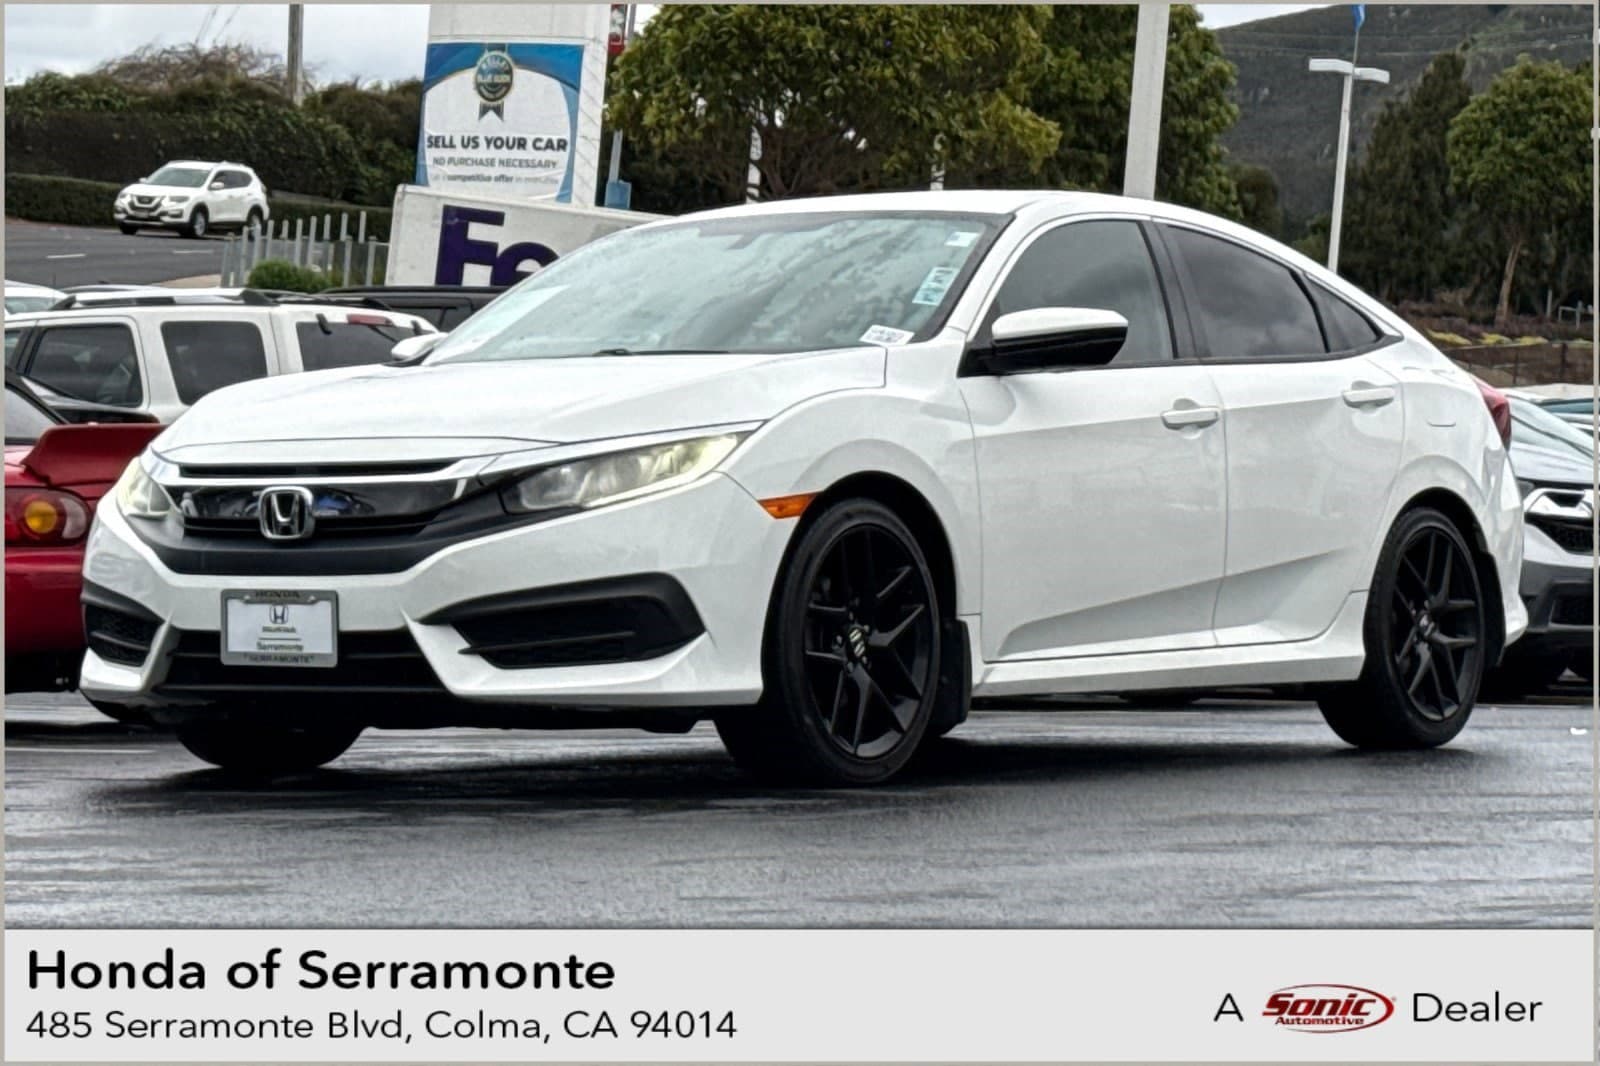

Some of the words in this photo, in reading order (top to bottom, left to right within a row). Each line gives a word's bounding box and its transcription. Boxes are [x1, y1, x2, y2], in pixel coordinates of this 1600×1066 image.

[427, 135, 456, 149] SELL
[461, 136, 480, 149] US
[484, 136, 527, 150] YOUR
[532, 137, 568, 152] CAR
[433, 157, 445, 166] NO
[447, 157, 496, 168] PURCHASE
[500, 158, 558, 169] NECESSARY
[447, 174, 492, 183] competitive
[494, 174, 514, 183] offer
